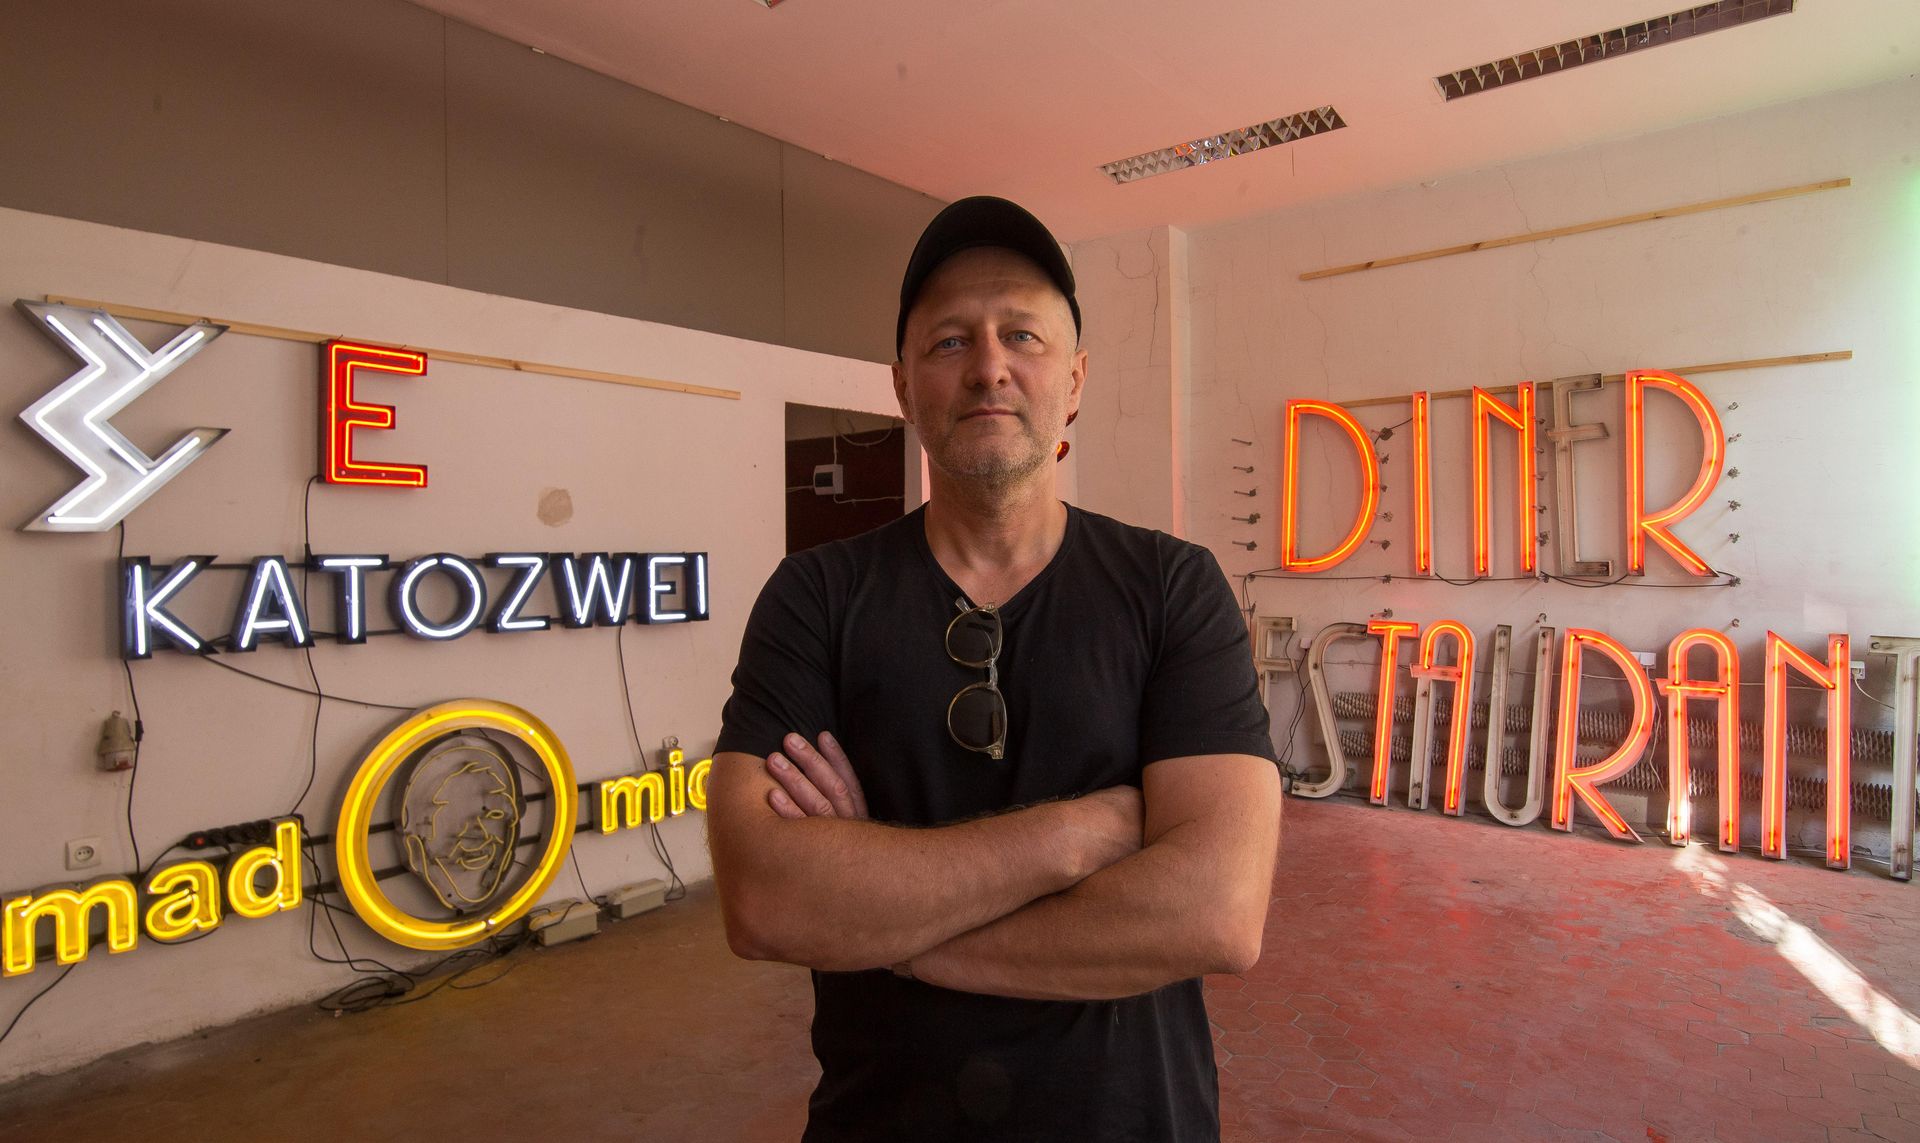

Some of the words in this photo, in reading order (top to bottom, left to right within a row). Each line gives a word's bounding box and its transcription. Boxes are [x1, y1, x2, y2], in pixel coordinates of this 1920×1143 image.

[320, 339, 428, 488] E
[1282, 370, 1724, 578] DINER
[121, 552, 709, 660] KATOZWEI
[1, 816, 303, 977] mad
